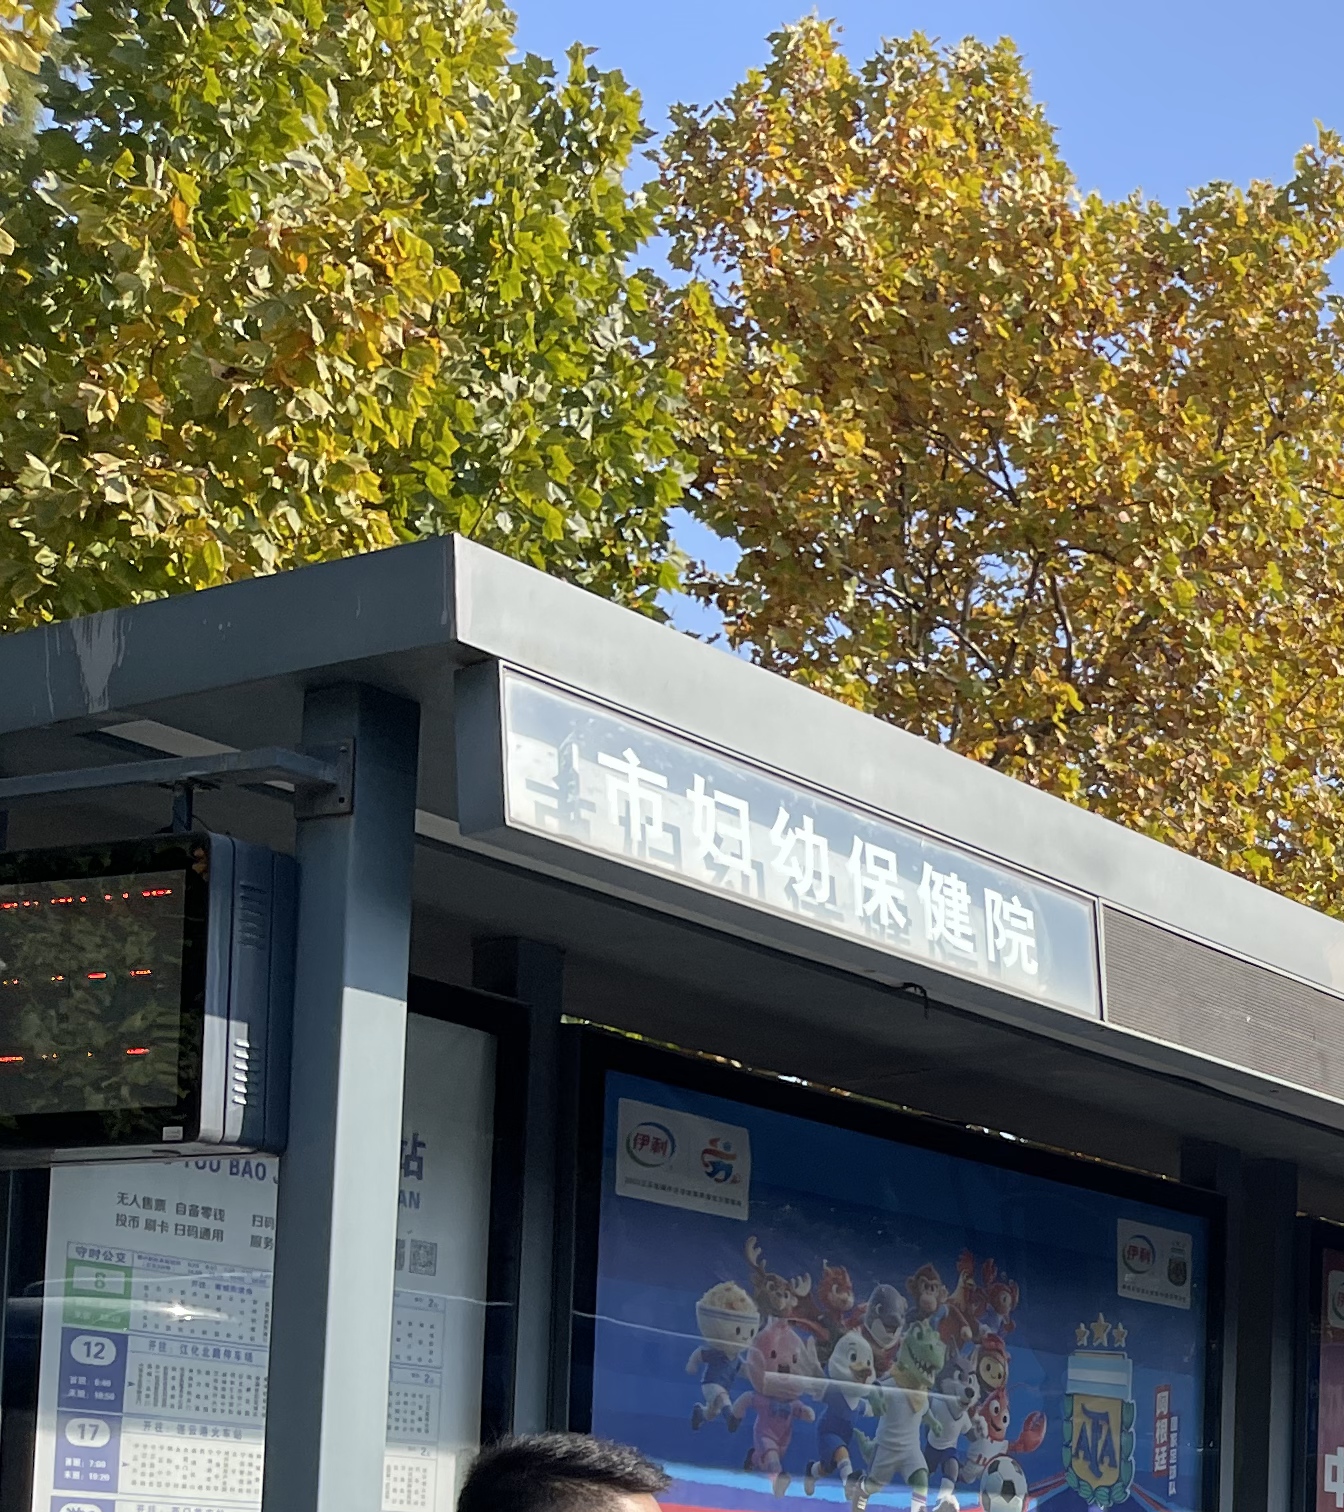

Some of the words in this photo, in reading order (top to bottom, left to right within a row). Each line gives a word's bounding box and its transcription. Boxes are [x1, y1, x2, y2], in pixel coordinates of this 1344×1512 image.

[597, 747, 1039, 976] 市妇幼保健院
[633, 1132, 668, 1157] 伊利
[116, 1191, 167, 1214] 无人售票
[175, 1202, 226, 1222] 自备零钱
[115, 1213, 140, 1229] 投币
[144, 1218, 169, 1234] 刷卡
[174, 1223, 225, 1243] 扫码通用
[83, 1341, 106, 1360] 12
[77, 1423, 100, 1442] 17
[1154, 1391, 1169, 1473] 阿根廷
